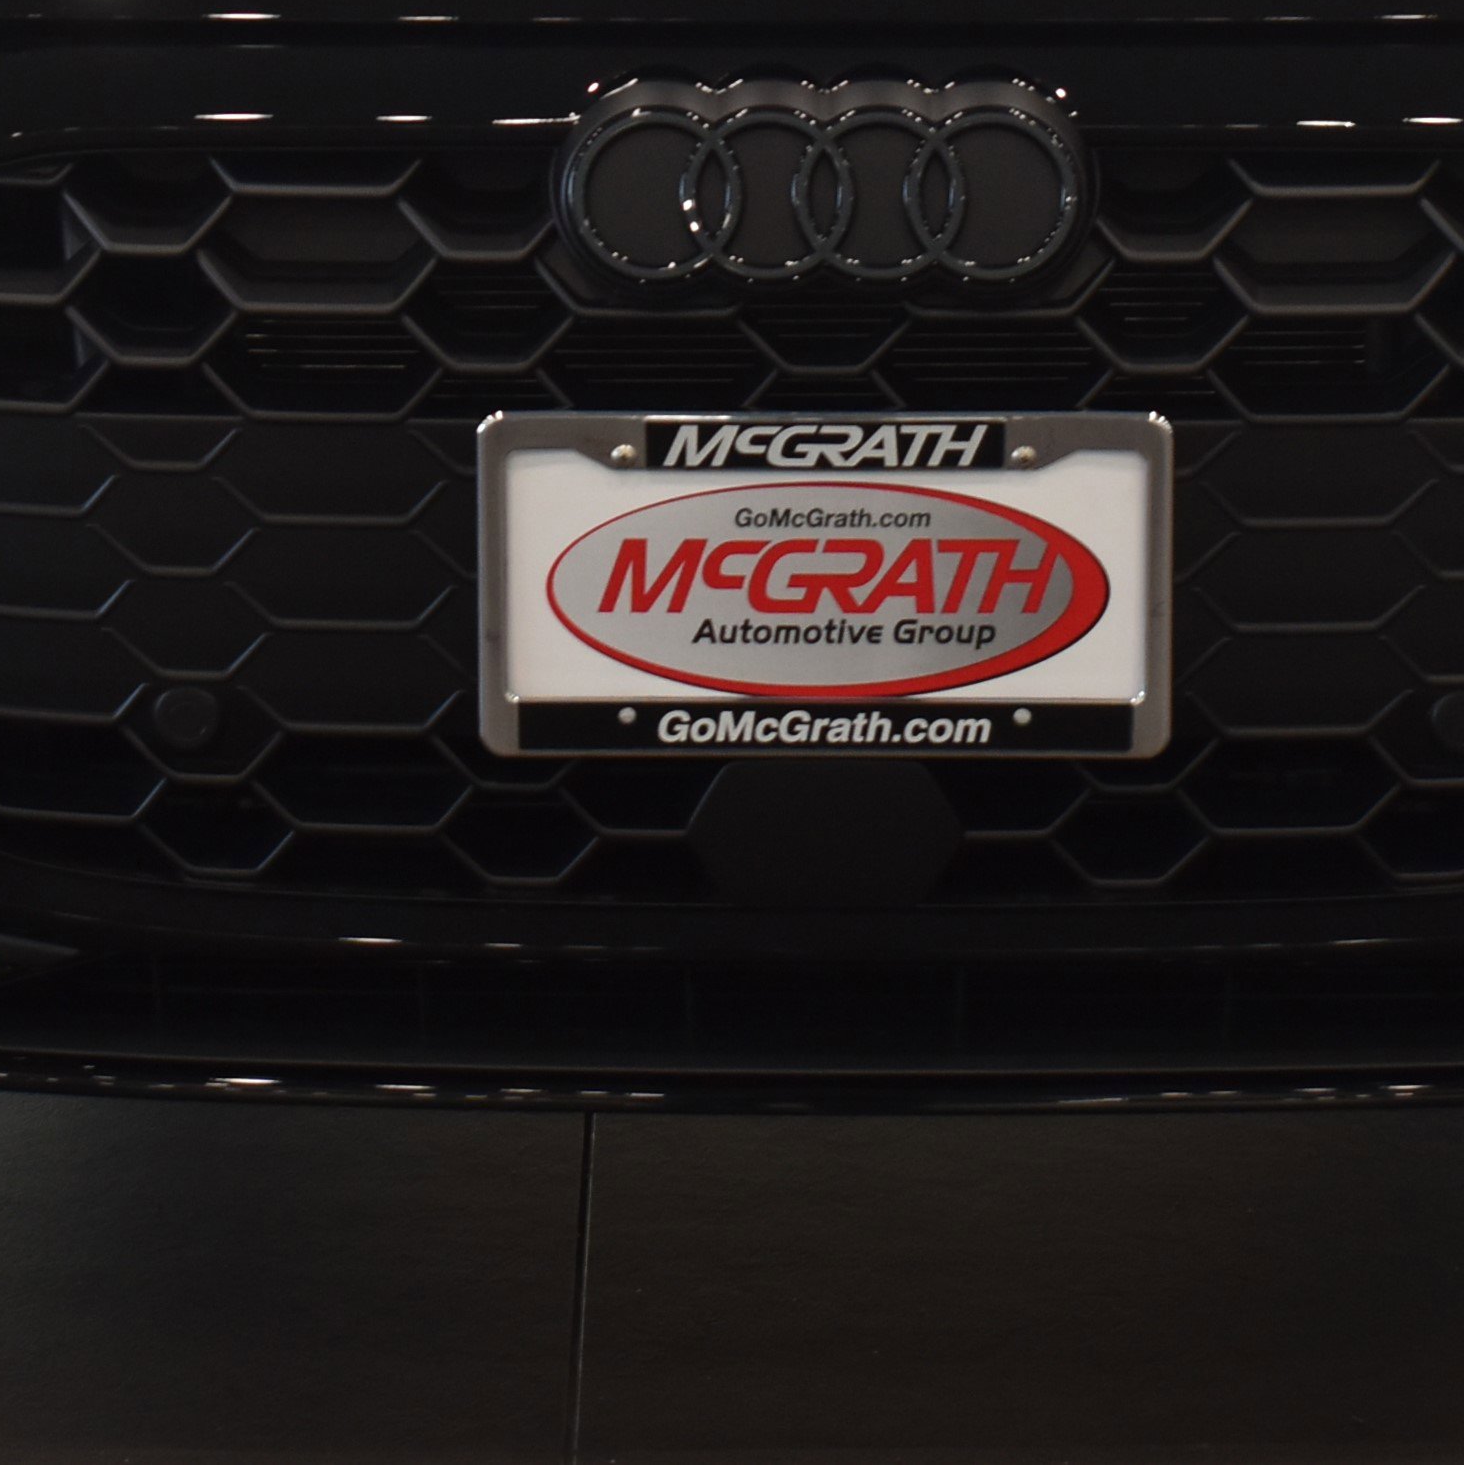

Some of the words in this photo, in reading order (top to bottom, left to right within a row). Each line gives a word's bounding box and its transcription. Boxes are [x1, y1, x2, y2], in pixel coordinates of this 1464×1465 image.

[734, 507, 932, 530] GoMcGrath.com
[692, 619, 884, 646] Automotive
[893, 619, 997, 650] Group
[657, 709, 992, 744] GoMcGrath.com
